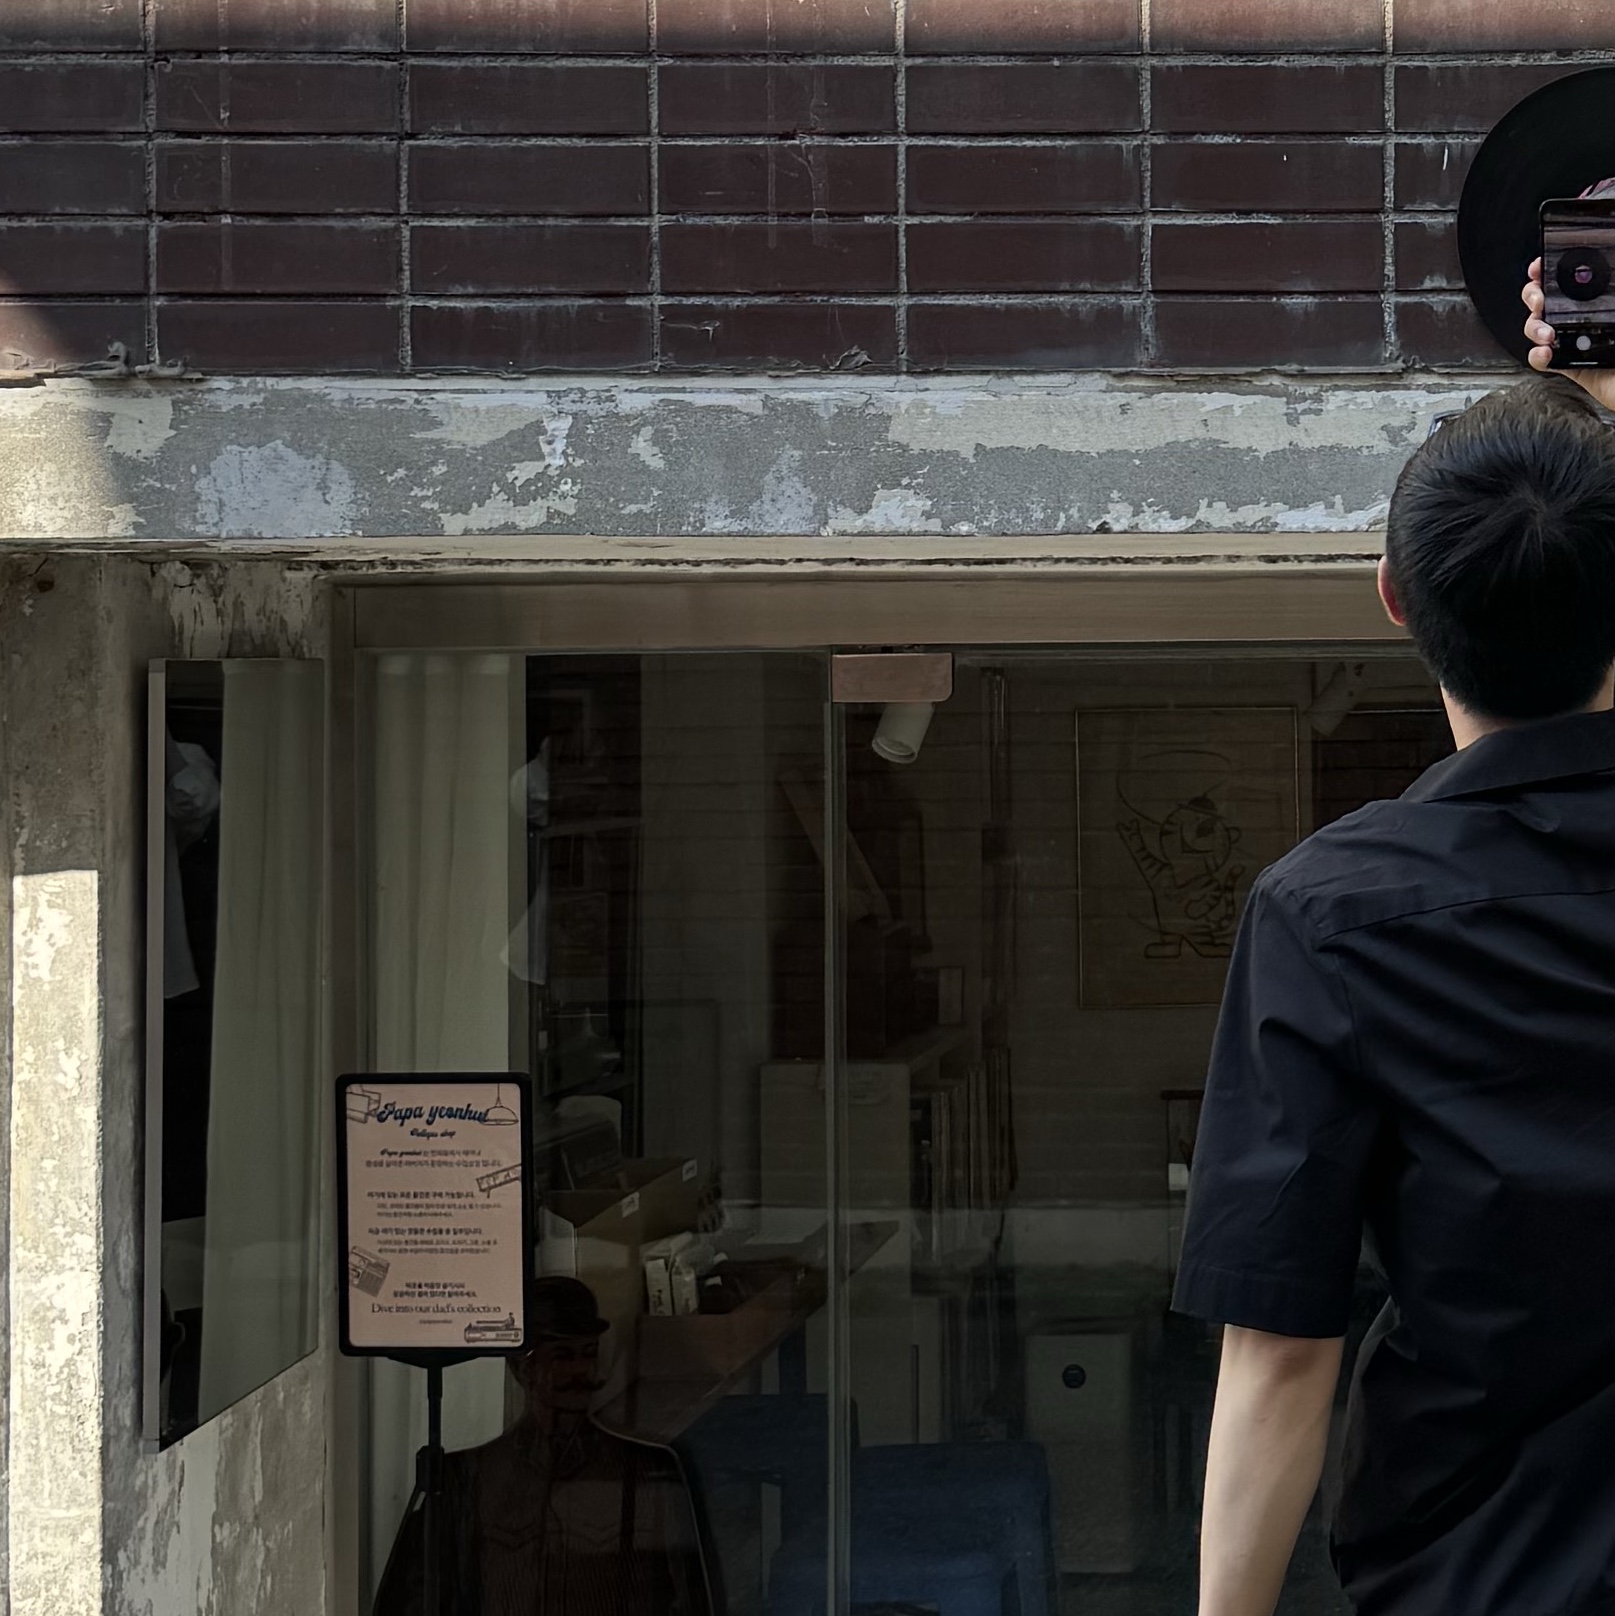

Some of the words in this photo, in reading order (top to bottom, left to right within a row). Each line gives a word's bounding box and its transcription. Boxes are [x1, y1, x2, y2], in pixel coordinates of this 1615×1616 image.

[376, 1101, 425, 1127] Papa
[371, 1303, 394, 1314] Dive
[395, 1303, 414, 1314] into
[414, 1304, 431, 1314] our
[456, 1303, 501, 1314] collection
